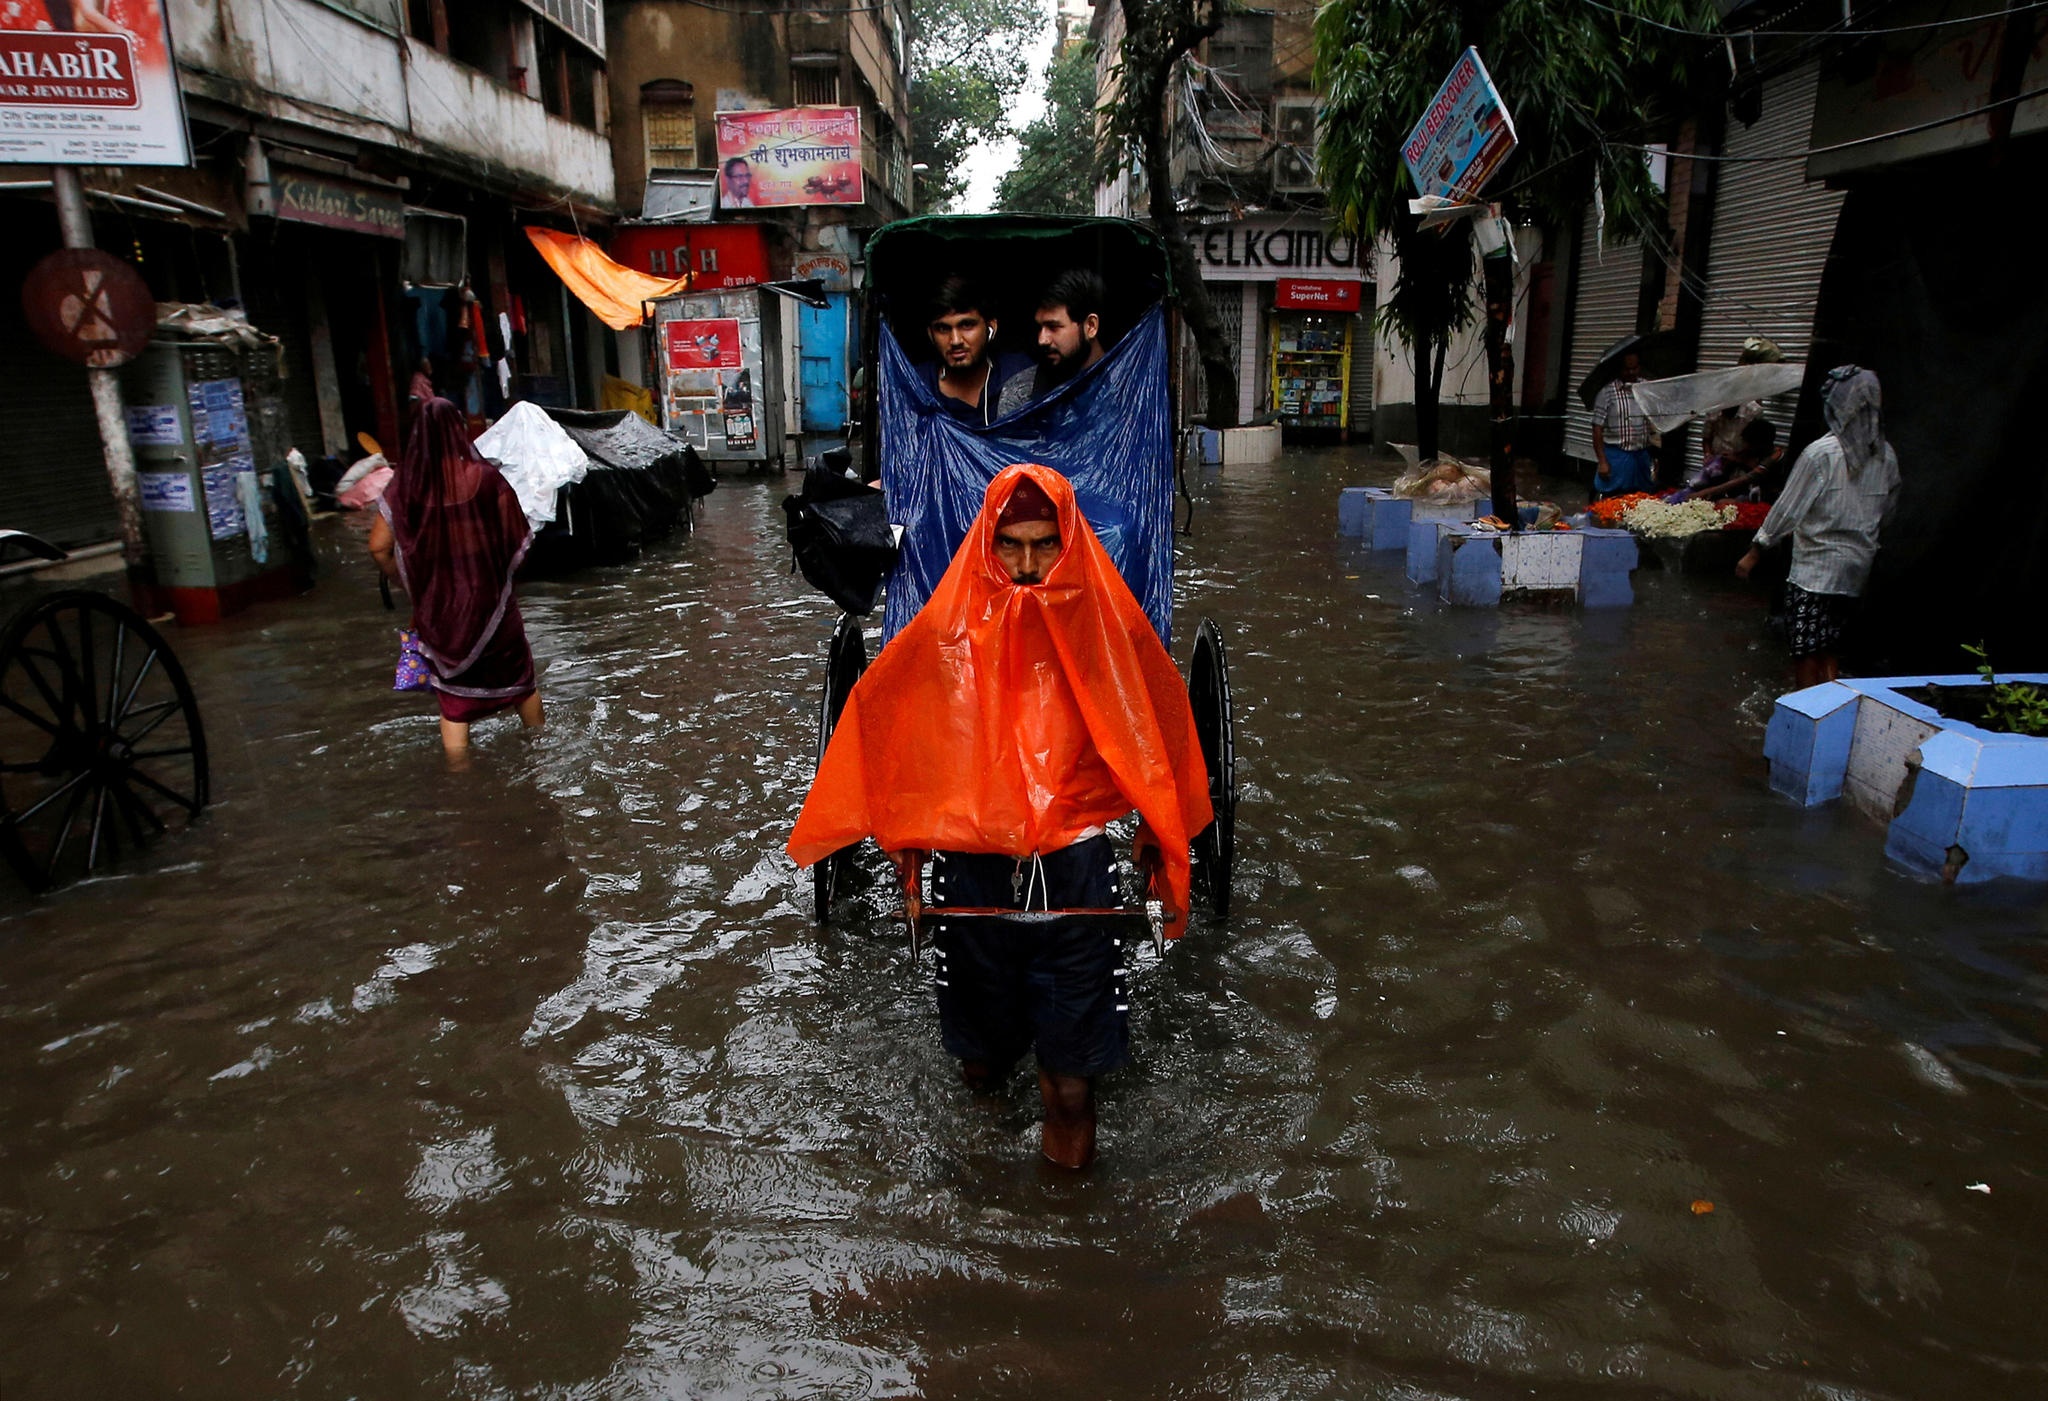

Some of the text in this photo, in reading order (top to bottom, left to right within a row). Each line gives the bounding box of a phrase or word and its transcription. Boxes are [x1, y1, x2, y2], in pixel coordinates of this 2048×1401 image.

[31, 85, 129, 99] JEWELLERS
[1405, 130, 1427, 165] ROJI
[1427, 60, 1476, 136] BEDCOVER
[750, 144, 768, 163] की
[1290, 291, 1329, 301] SuperNet
